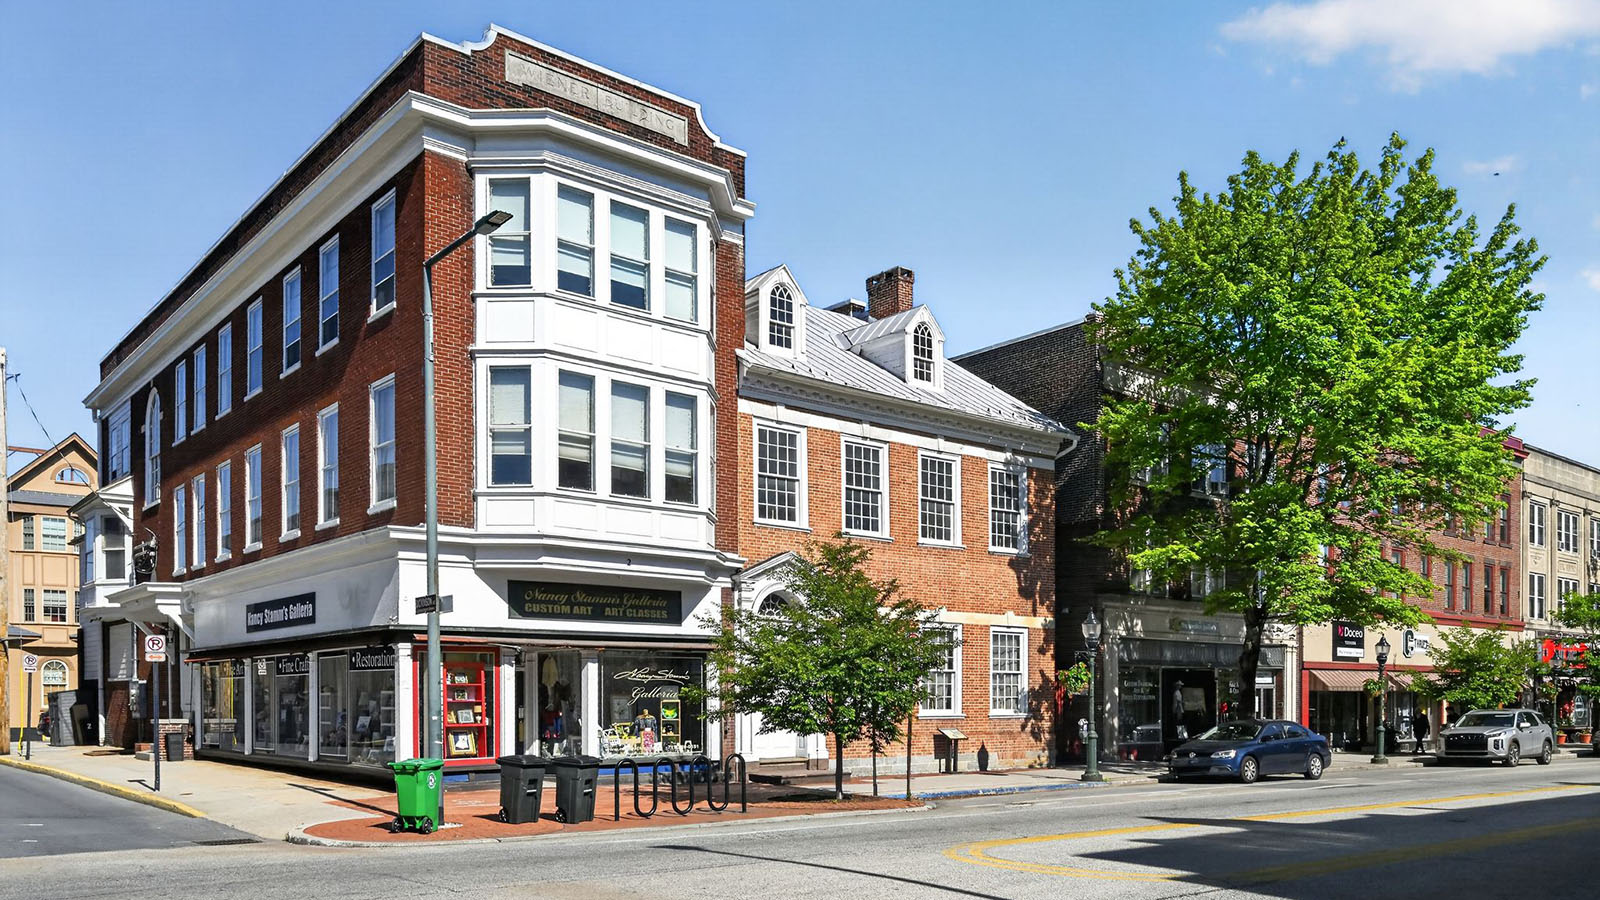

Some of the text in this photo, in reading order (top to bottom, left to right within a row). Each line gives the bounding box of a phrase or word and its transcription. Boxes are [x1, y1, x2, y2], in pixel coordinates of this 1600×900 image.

[520, 64, 676, 131] WIENER BUILDING
[525, 588, 568, 604] Nancy
[623, 593, 667, 608] Galleria
[247, 601, 313, 626] Nancy Stamm's Galleria
[525, 603, 668, 619] CUSTOM ART ART CLASSES
[1344, 627, 1363, 638] Doceo
[282, 658, 294, 672] Fine
[614, 667, 657, 683] Nancy
[627, 686, 678, 706] Galleria
